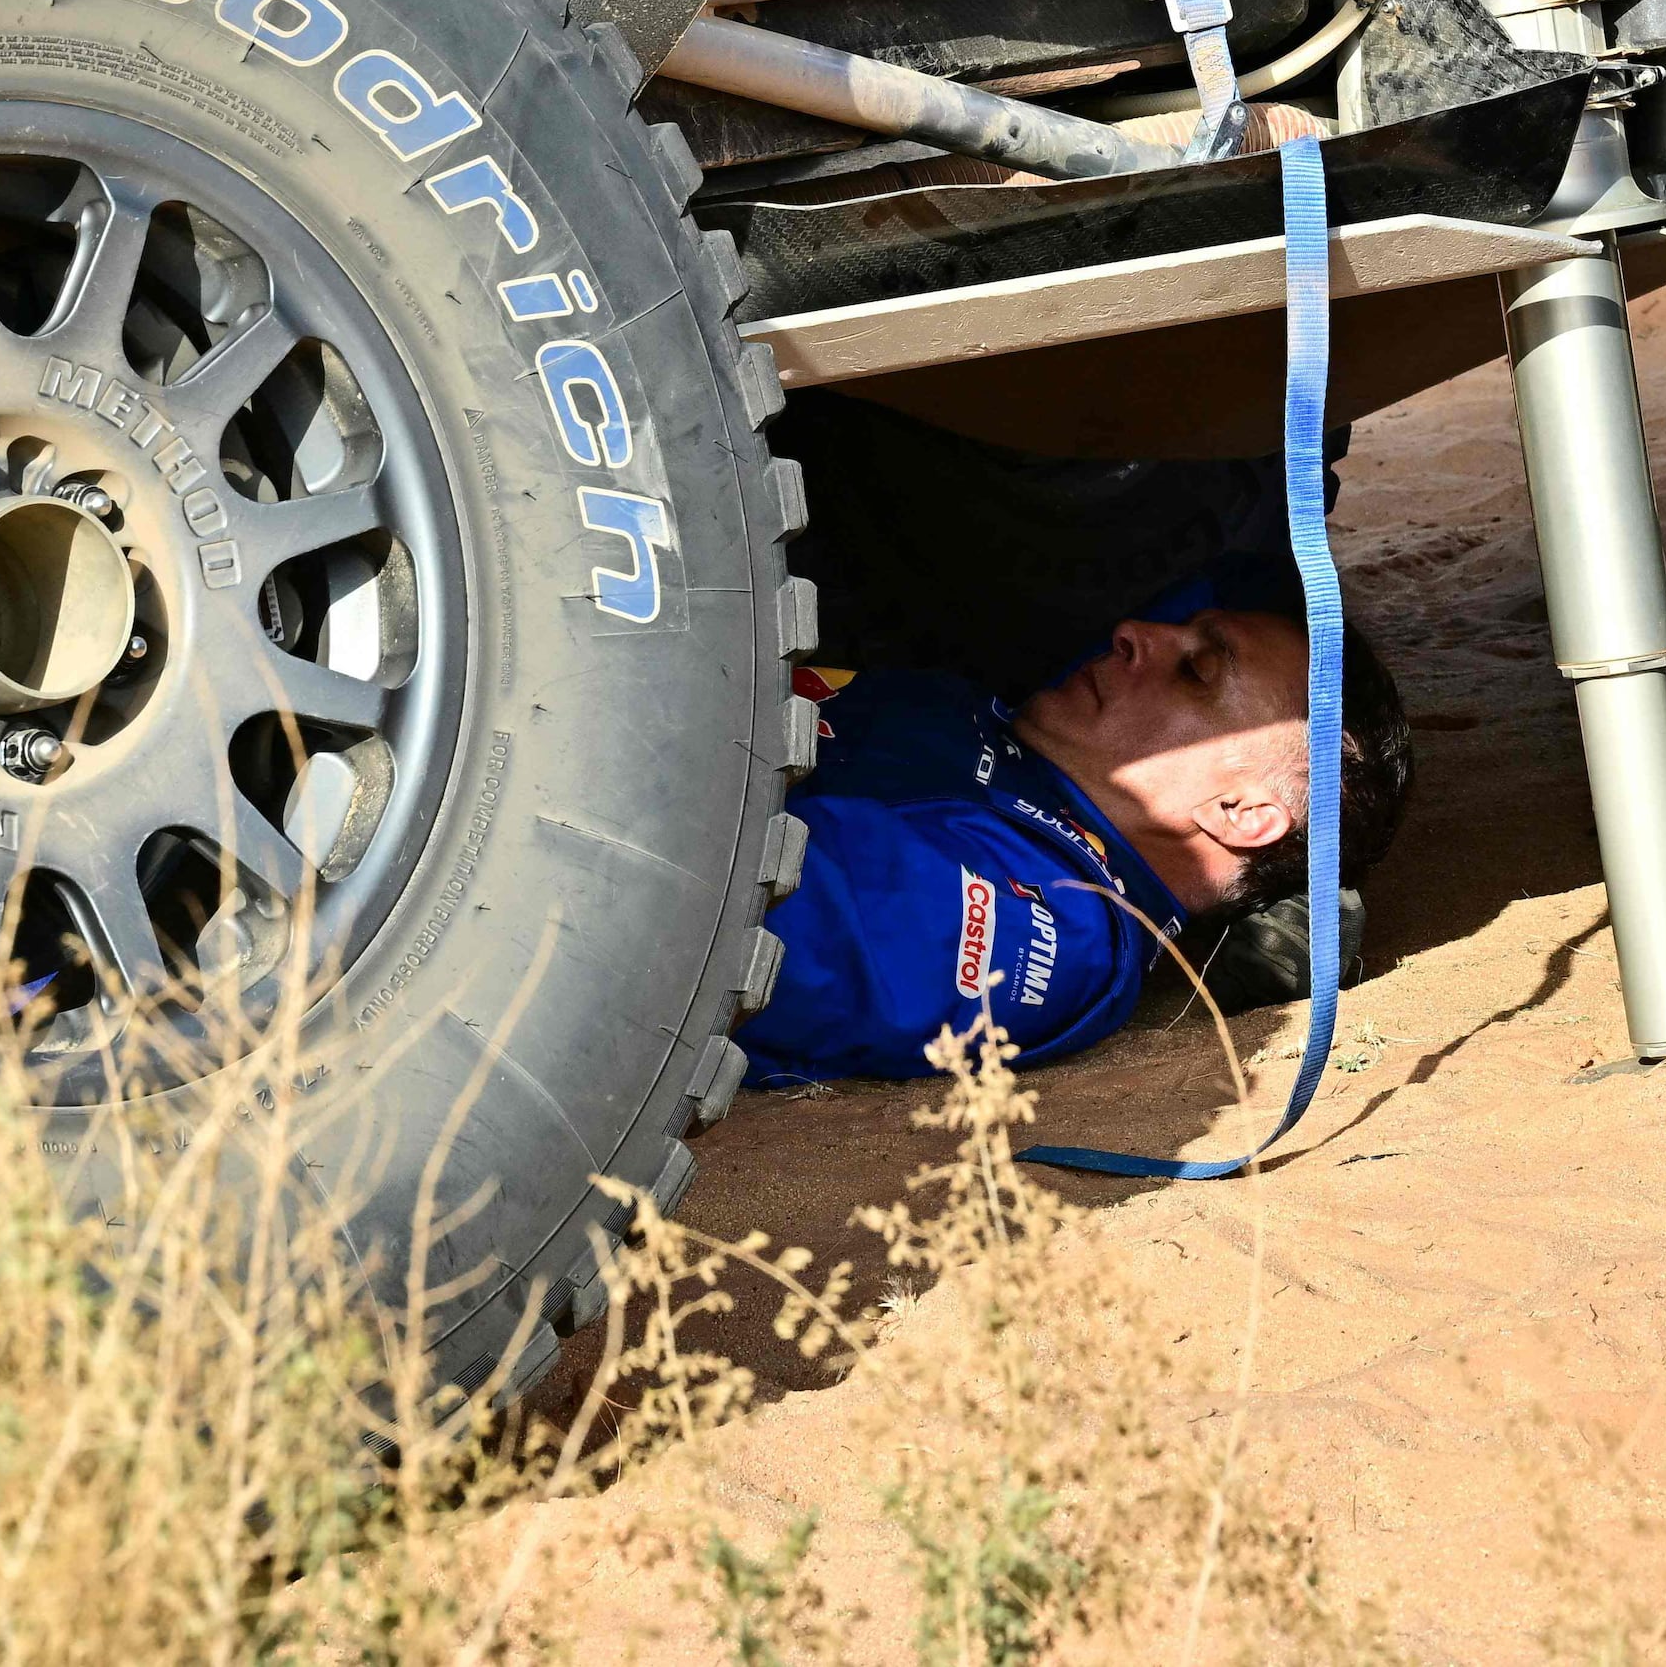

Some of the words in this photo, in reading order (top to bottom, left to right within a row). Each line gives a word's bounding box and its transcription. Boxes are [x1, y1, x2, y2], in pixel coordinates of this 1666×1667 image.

[38, 354, 244, 592] METHOD
[472, 431, 499, 495] DANGER
[486, 729, 511, 772] FOR
[440, 775, 501, 909] COMPETITION
[960, 882, 991, 993] Castrol
[1019, 902, 1058, 1007] OPTIMA
